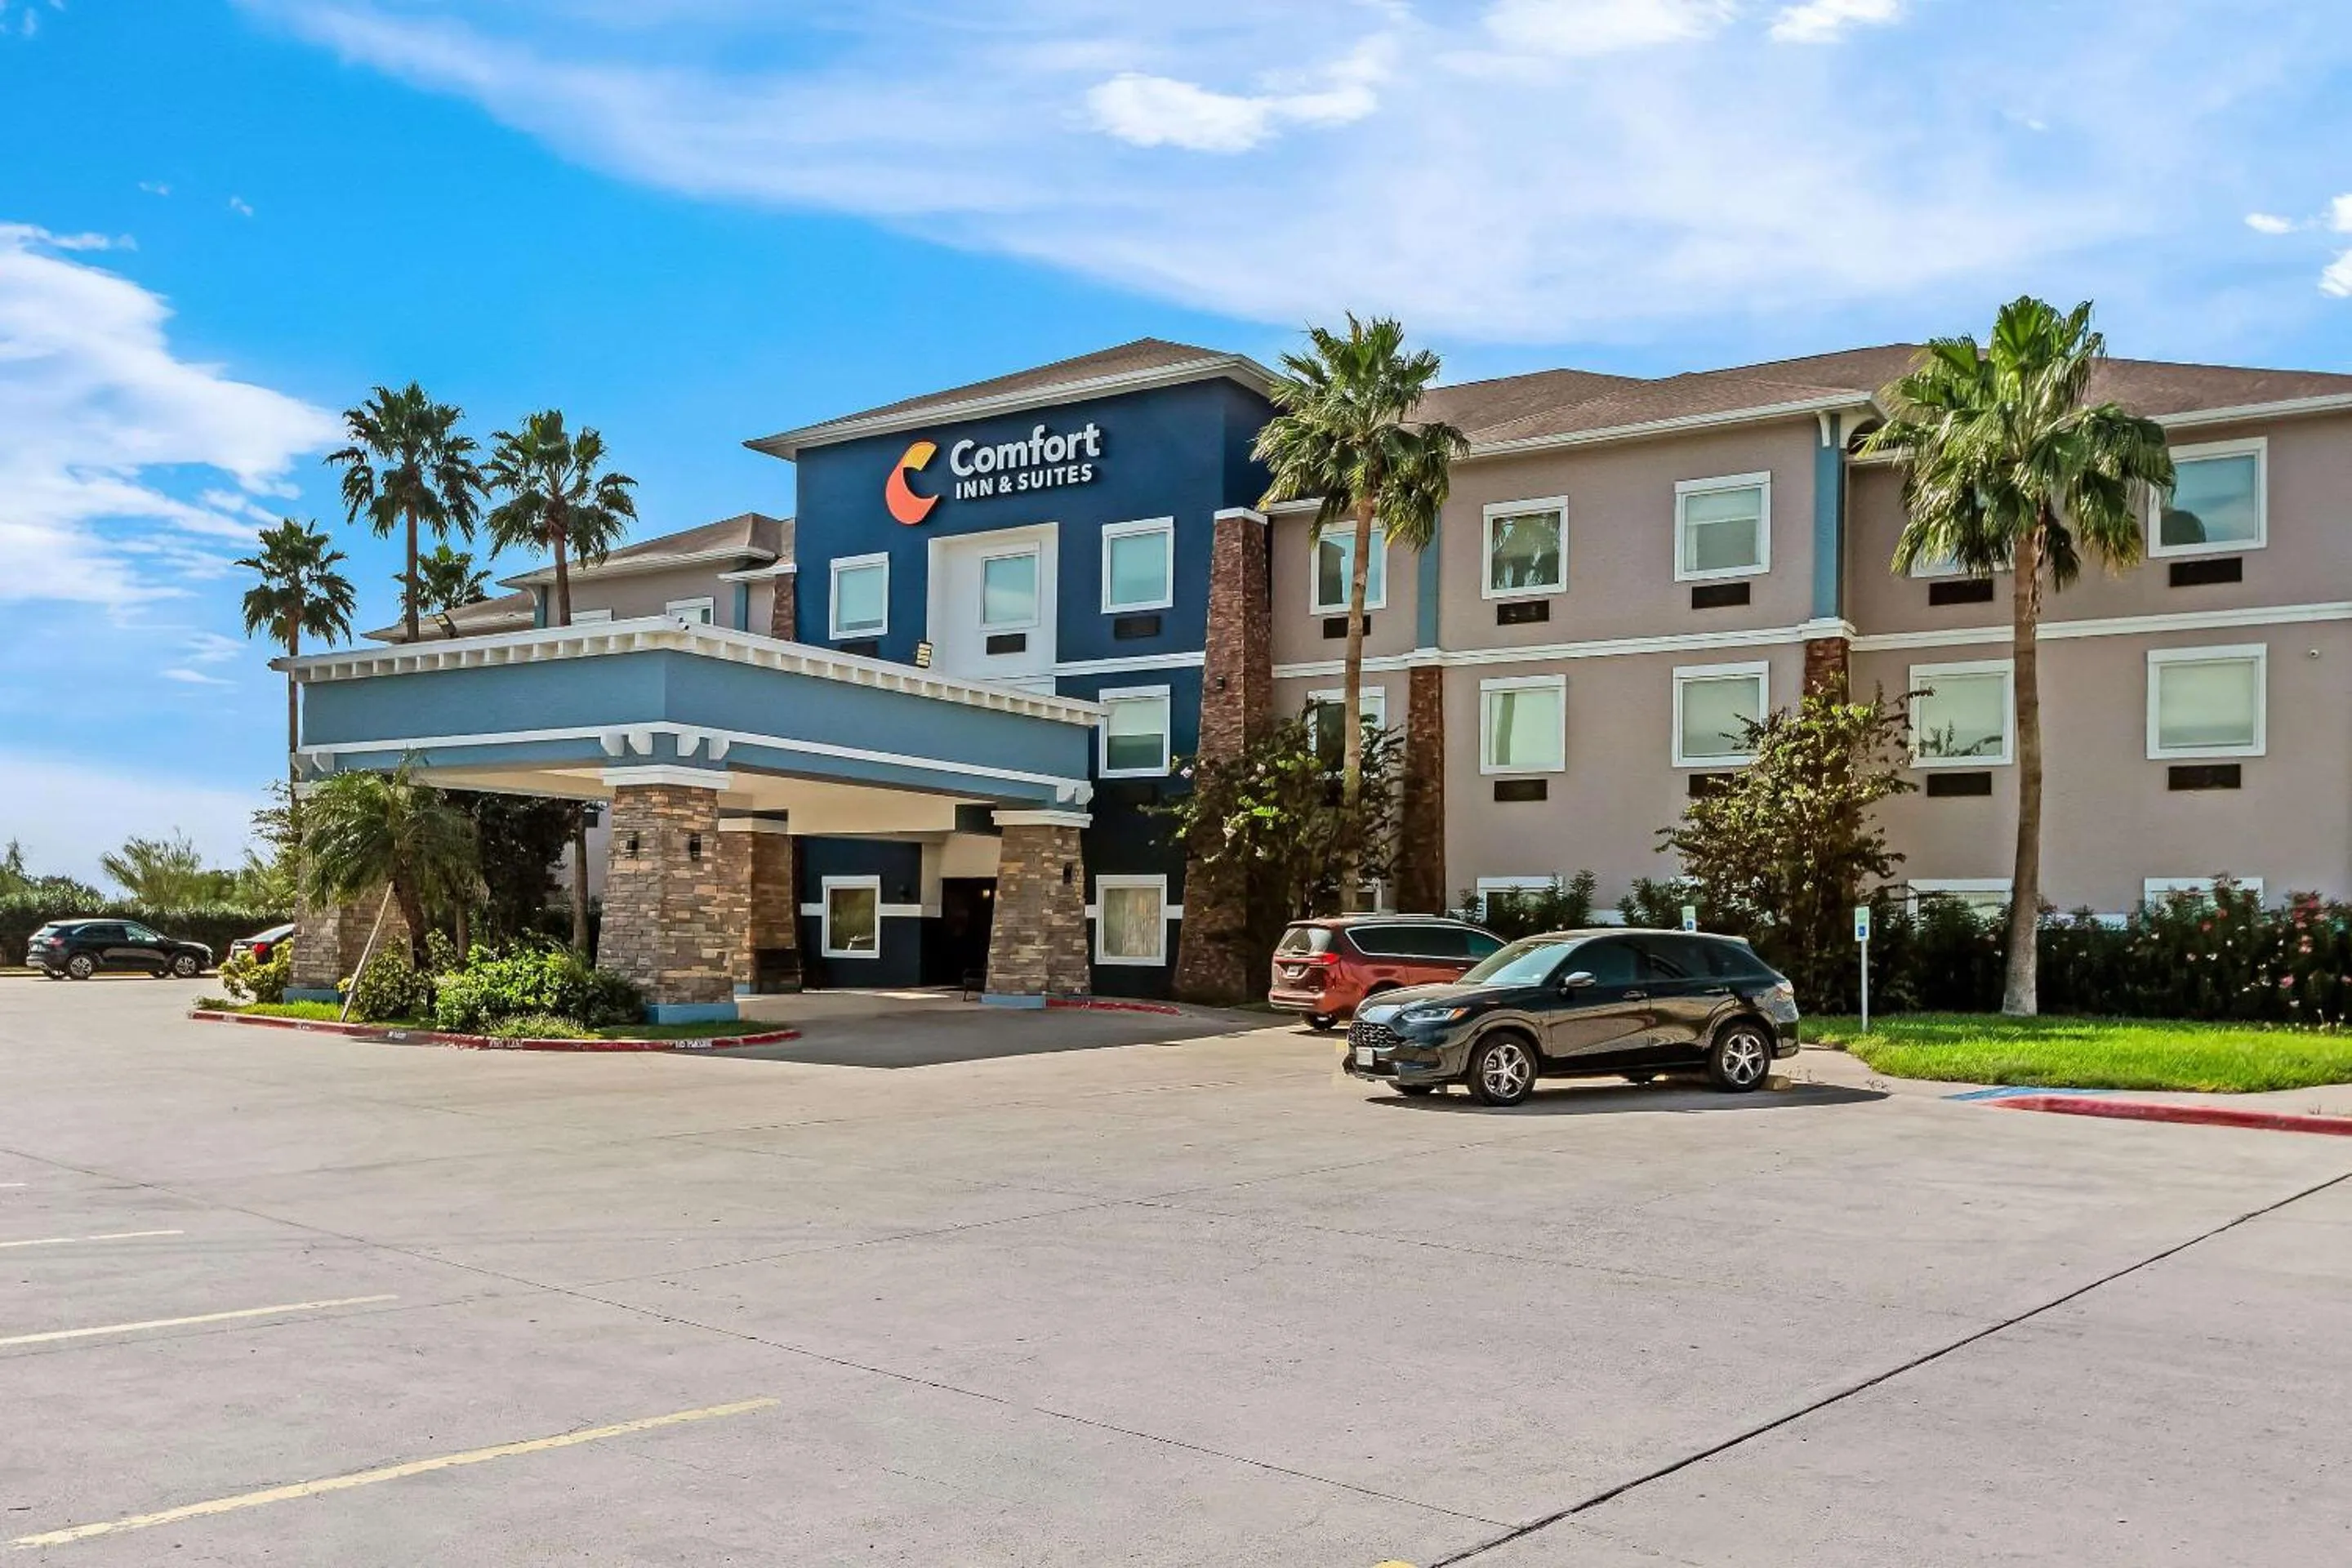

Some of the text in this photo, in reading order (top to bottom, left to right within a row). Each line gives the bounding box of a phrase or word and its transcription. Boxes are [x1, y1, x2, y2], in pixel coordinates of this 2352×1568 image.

[950, 423, 1100, 476] Comfort
[956, 463, 1093, 499] INN & SUITES
